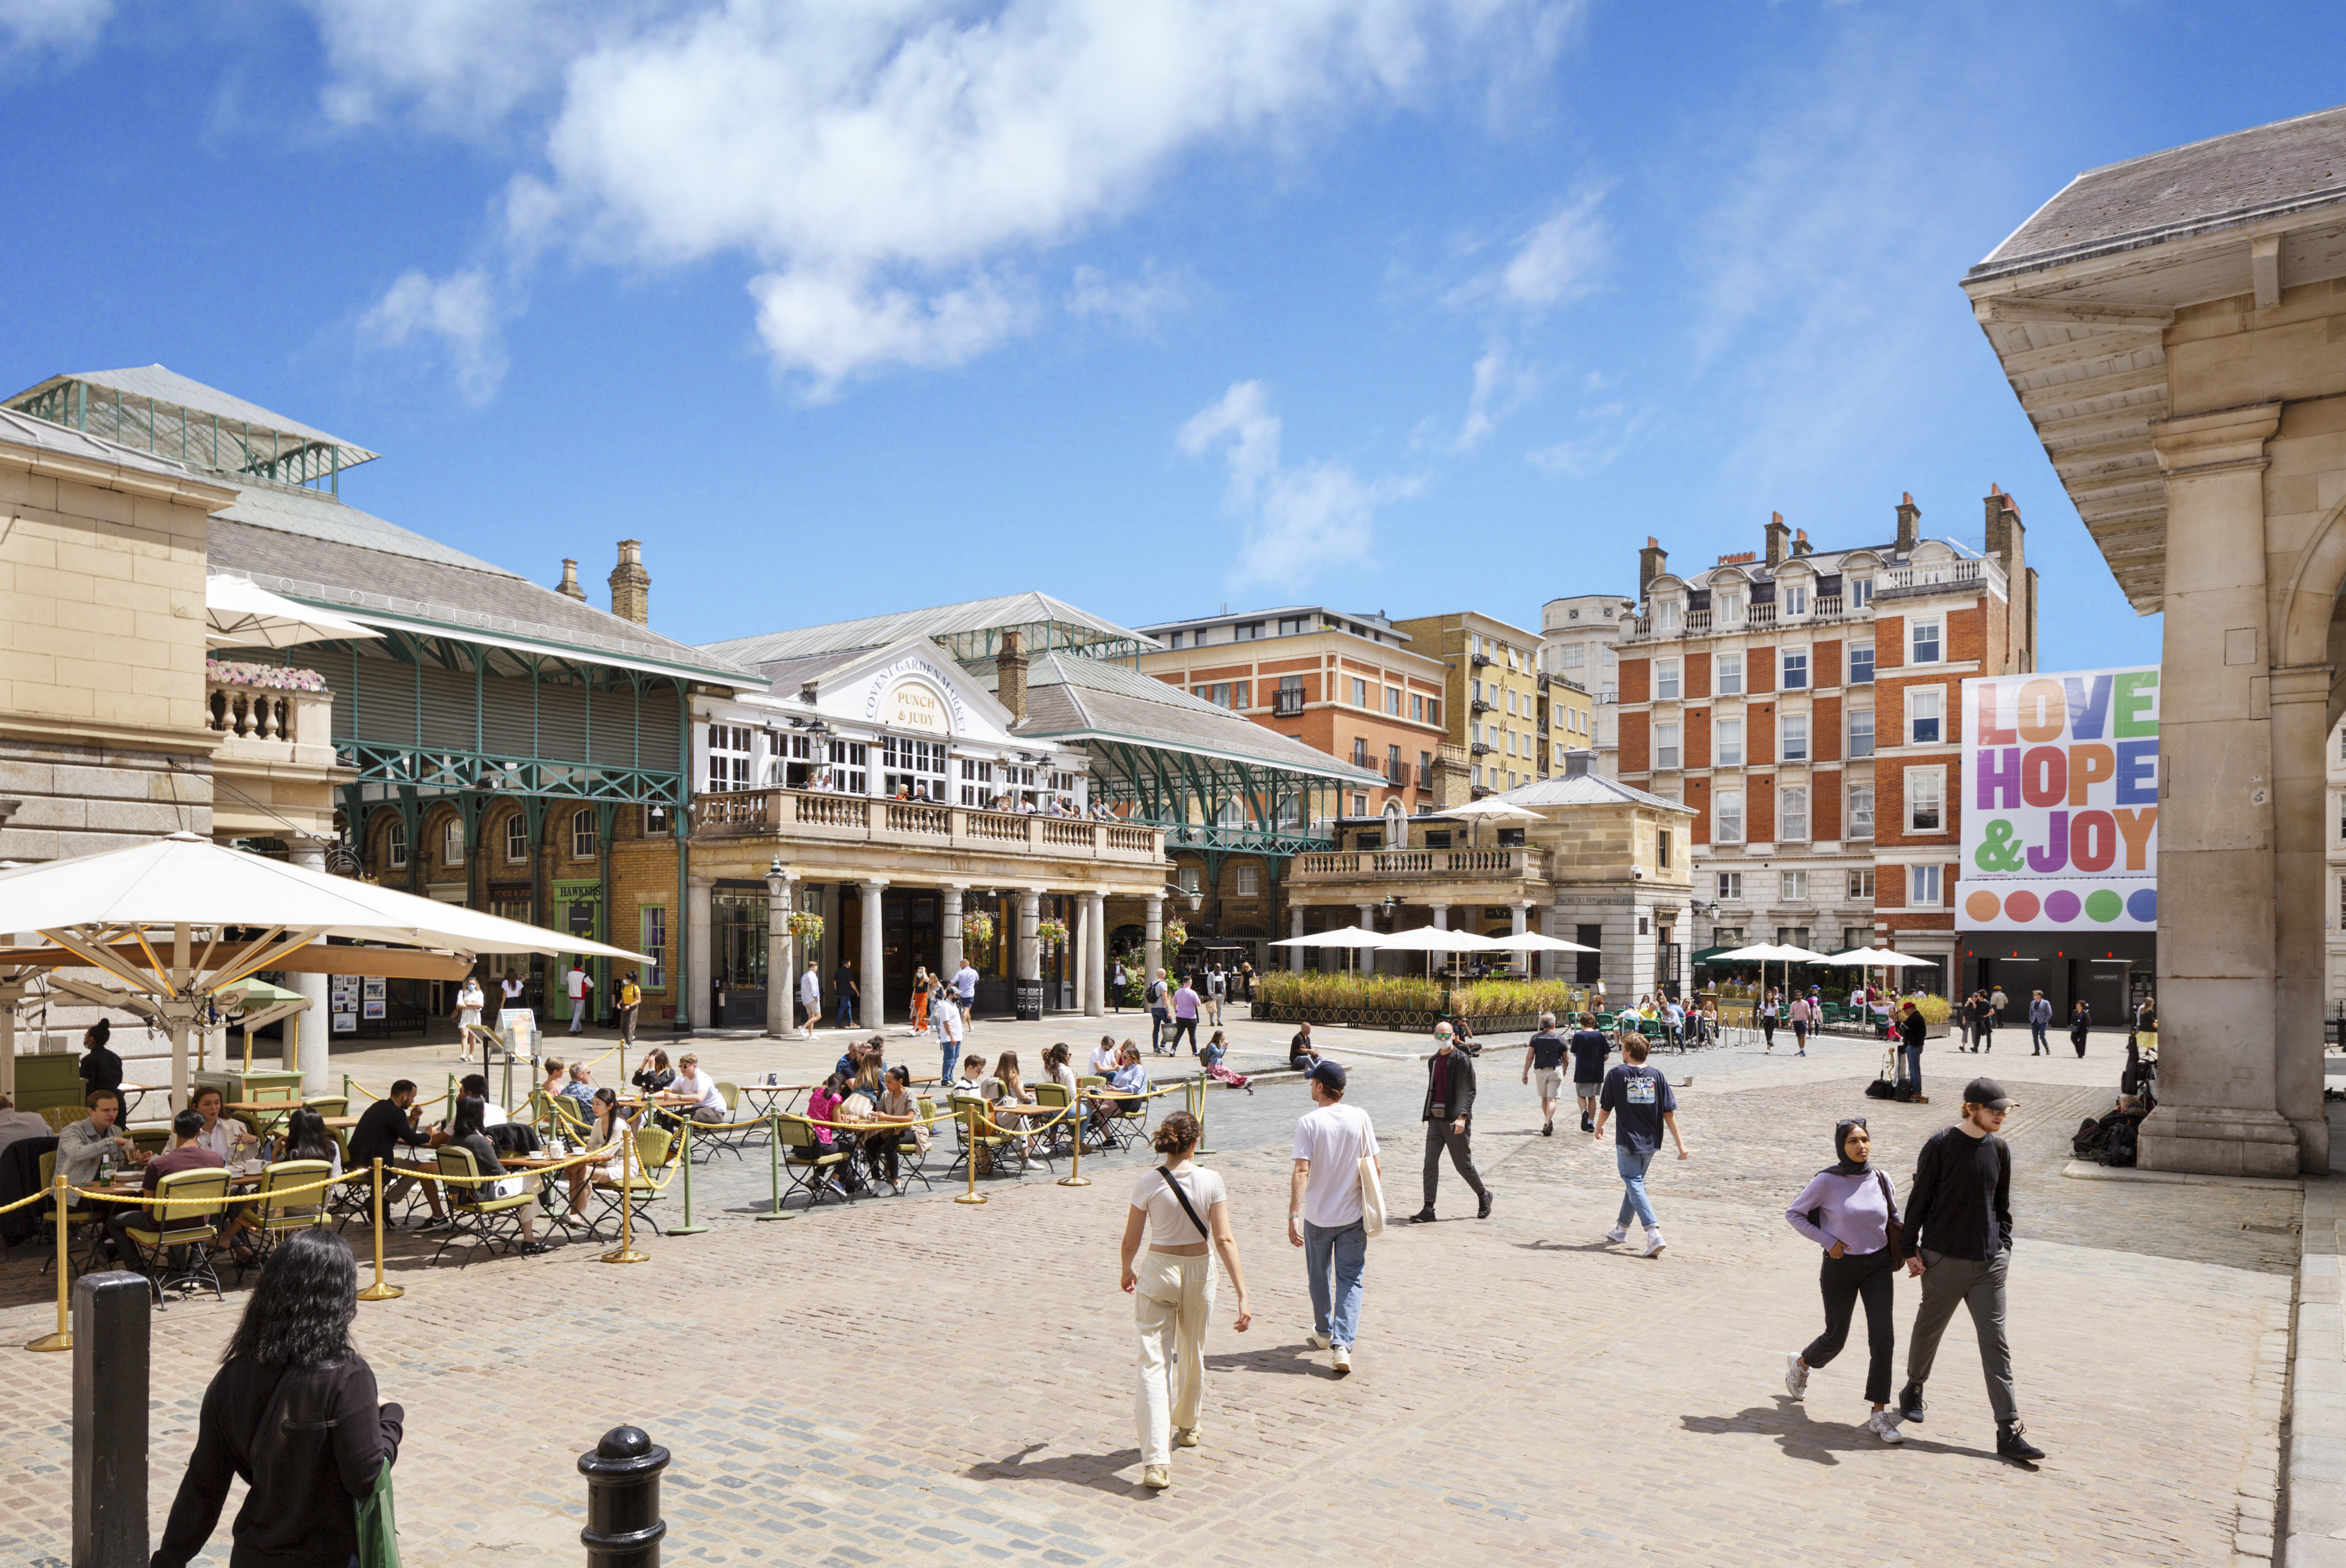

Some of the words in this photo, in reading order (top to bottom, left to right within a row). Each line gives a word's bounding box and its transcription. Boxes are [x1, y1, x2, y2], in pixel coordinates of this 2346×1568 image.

[866, 665, 894, 719] COVENT
[895, 659, 941, 680] GARDEN
[940, 675, 966, 735] MARKET
[898, 692, 934, 709] PUNCH
[898, 710, 905, 721] &
[908, 712, 934, 726] JUDY
[1977, 671, 2159, 746] LOVE
[1976, 740, 2159, 810] HOPE
[1975, 819, 2025, 872] &
[2027, 807, 2158, 873] JOY
[560, 886, 601, 897] HAWKERS
